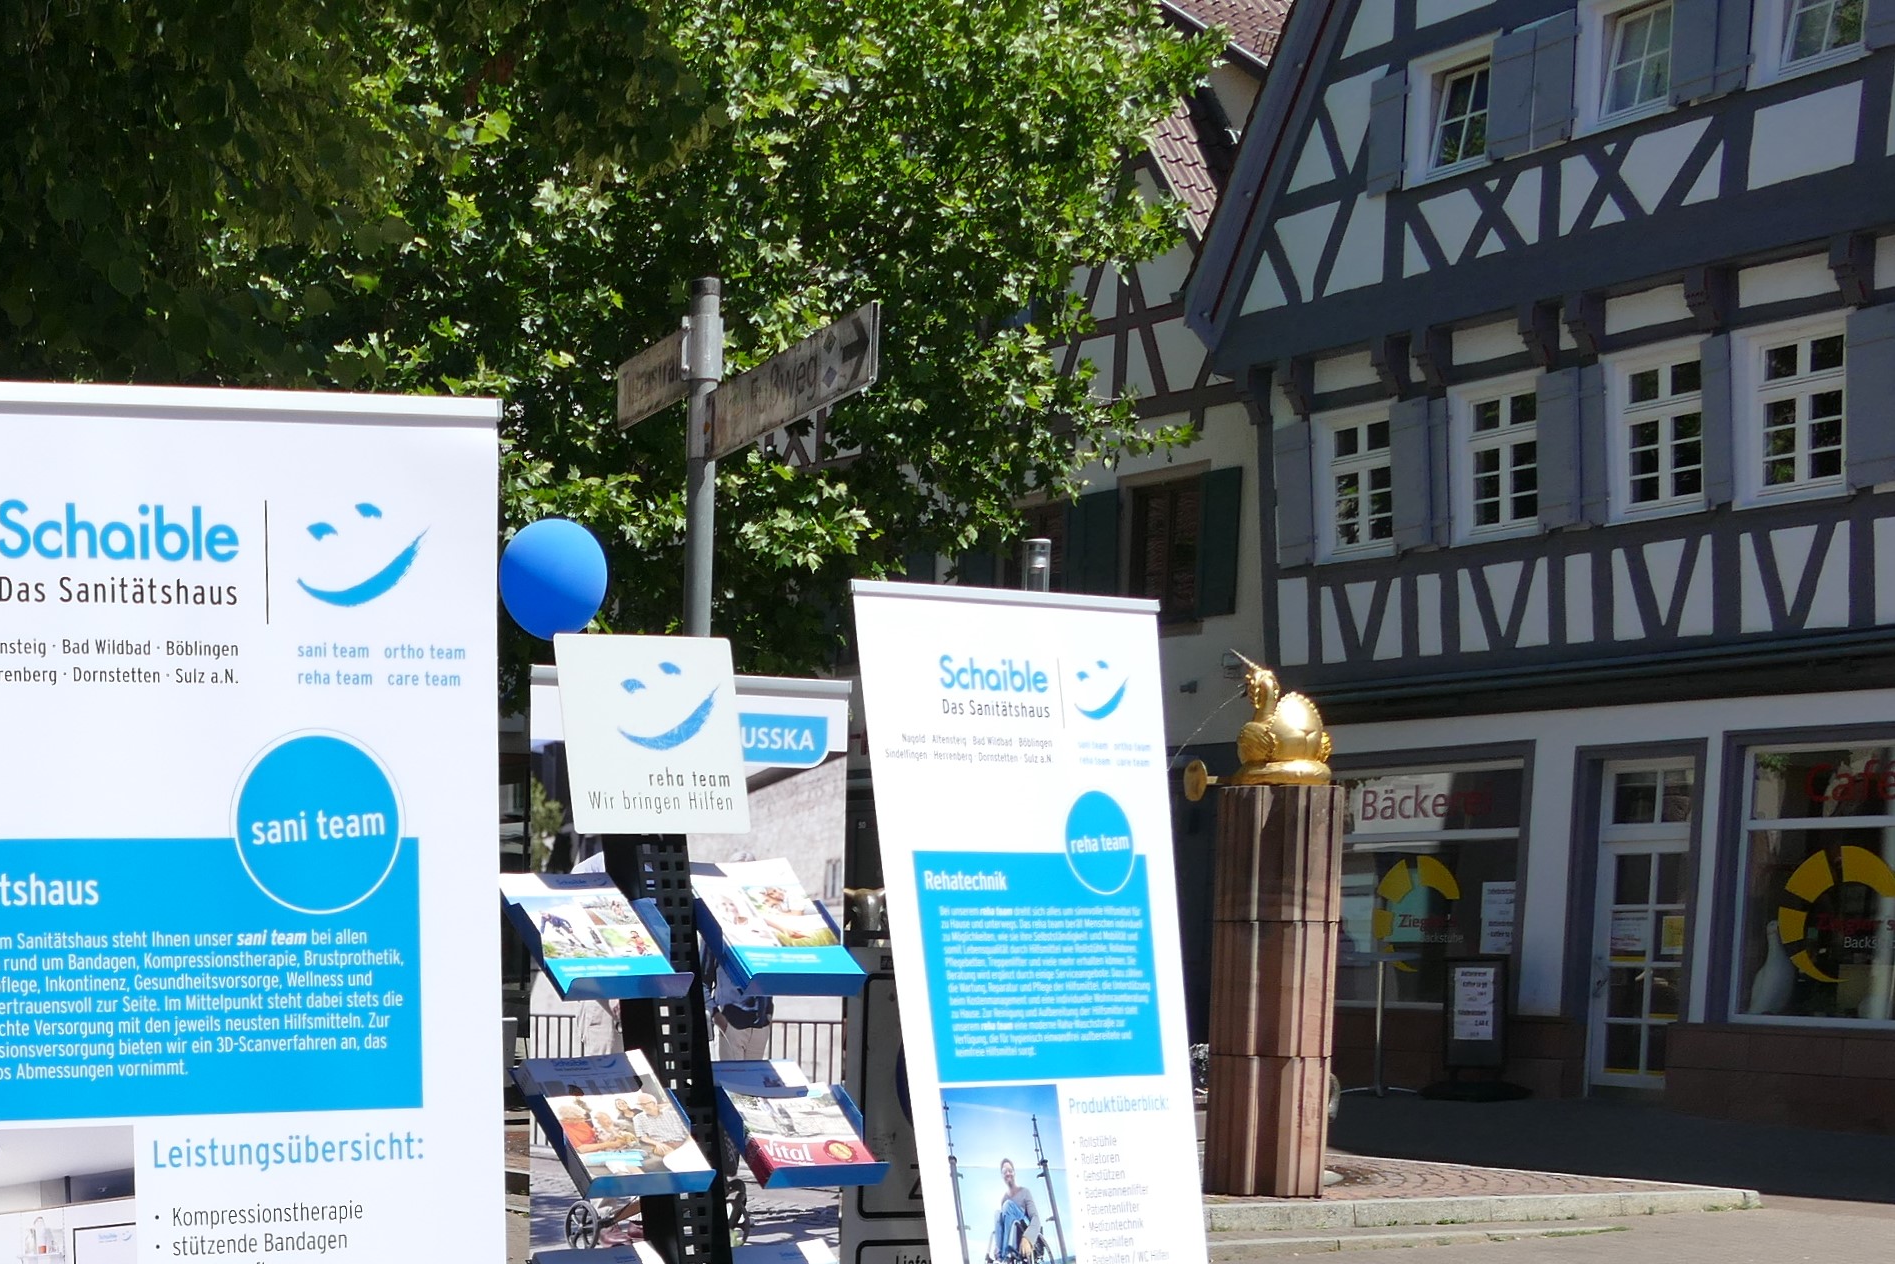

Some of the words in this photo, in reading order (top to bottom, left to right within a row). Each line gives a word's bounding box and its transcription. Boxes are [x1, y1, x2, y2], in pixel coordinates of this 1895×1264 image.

[59, 576, 238, 606] Sanitätshaus
[62, 638, 90, 655] Bad
[94, 639, 151, 656] Wildbad
[166, 640, 239, 661] Böblingen
[297, 642, 327, 658] sani
[331, 642, 370, 659] team
[383, 643, 425, 660] ortho
[429, 644, 466, 660] team
[72, 666, 161, 684] Dornstetten
[175, 667, 205, 684] Sulz
[210, 668, 239, 684] a.N.
[297, 669, 331, 686] reha
[335, 669, 373, 686] team
[387, 673, 420, 687] care
[424, 671, 461, 687] team
[939, 654, 1049, 694] Schaible
[942, 698, 965, 716] Das
[968, 699, 1051, 719] Sanitätshaus
[741, 726, 815, 751] USSKA
[648, 766, 684, 787] reha
[692, 771, 731, 788] team
[588, 790, 615, 810] Wir
[622, 790, 681, 815] bringen
[688, 790, 733, 811] Hilfen
[251, 810, 308, 846] sani
[315, 809, 386, 840] team
[1071, 835, 1099, 854] reha
[1101, 833, 1130, 852] team
[924, 871, 1007, 890] Rehatechnik
[16, 931, 109, 950] Sanitätshaus
[111, 931, 148, 948] steht
[151, 930, 191, 948] Ihnen
[194, 933, 234, 947] unser
[236, 928, 268, 947] sani
[270, 929, 308, 946] team
[310, 928, 332, 945] bei
[334, 928, 368, 945] allen
[3, 954, 38, 972] rund
[41, 956, 65, 972] um
[67, 953, 140, 974] Bandagen,
[143, 950, 301, 972] Kompressionstherapie,
[303, 948, 404, 969] Brustprothetik,
[45, 974, 131, 993] Inkontinenz,
[133, 972, 283, 992] Gesundheitsvorsorge,
[286, 970, 345, 988] Wellness
[347, 970, 374, 987] und
[95, 999, 119, 1013] zur
[122, 995, 161, 1013] Seite.
[164, 995, 182, 1011] Im
[185, 993, 264, 1013] Mittelpunkt
[267, 992, 303, 1010] steht
[305, 991, 343, 1009] dabei
[346, 991, 380, 1008] stets
[382, 990, 404, 1007] die
[33, 1019, 115, 1039] Versorgung
[118, 1016, 141, 1034] mit
[144, 1016, 171, 1034] den
[173, 1015, 222, 1037] jeweils
[225, 1014, 281, 1032] neusten
[283, 1012, 365, 1030] Hilfsmitteln.
[368, 1011, 391, 1029] Zur
[118, 1038, 163, 1056] bieten
[166, 1037, 188, 1054] wir
[191, 1036, 213, 1054] ein
[216, 1034, 337, 1053] 3D-Scanverfahren
[340, 1036, 361, 1051] an,
[363, 1033, 388, 1050] das
[15, 1062, 115, 1082] Abmessungen
[117, 1058, 188, 1077] vornimmt.
[1068, 1095, 1169, 1114] Produktüberblick:
[153, 1131, 424, 1172] Leistungsübersicht:
[763, 1140, 814, 1161] Vital
[172, 1199, 363, 1230] Kompressionstherapie
[172, 1233, 258, 1257] stützende
[264, 1230, 348, 1255] Bandagen
